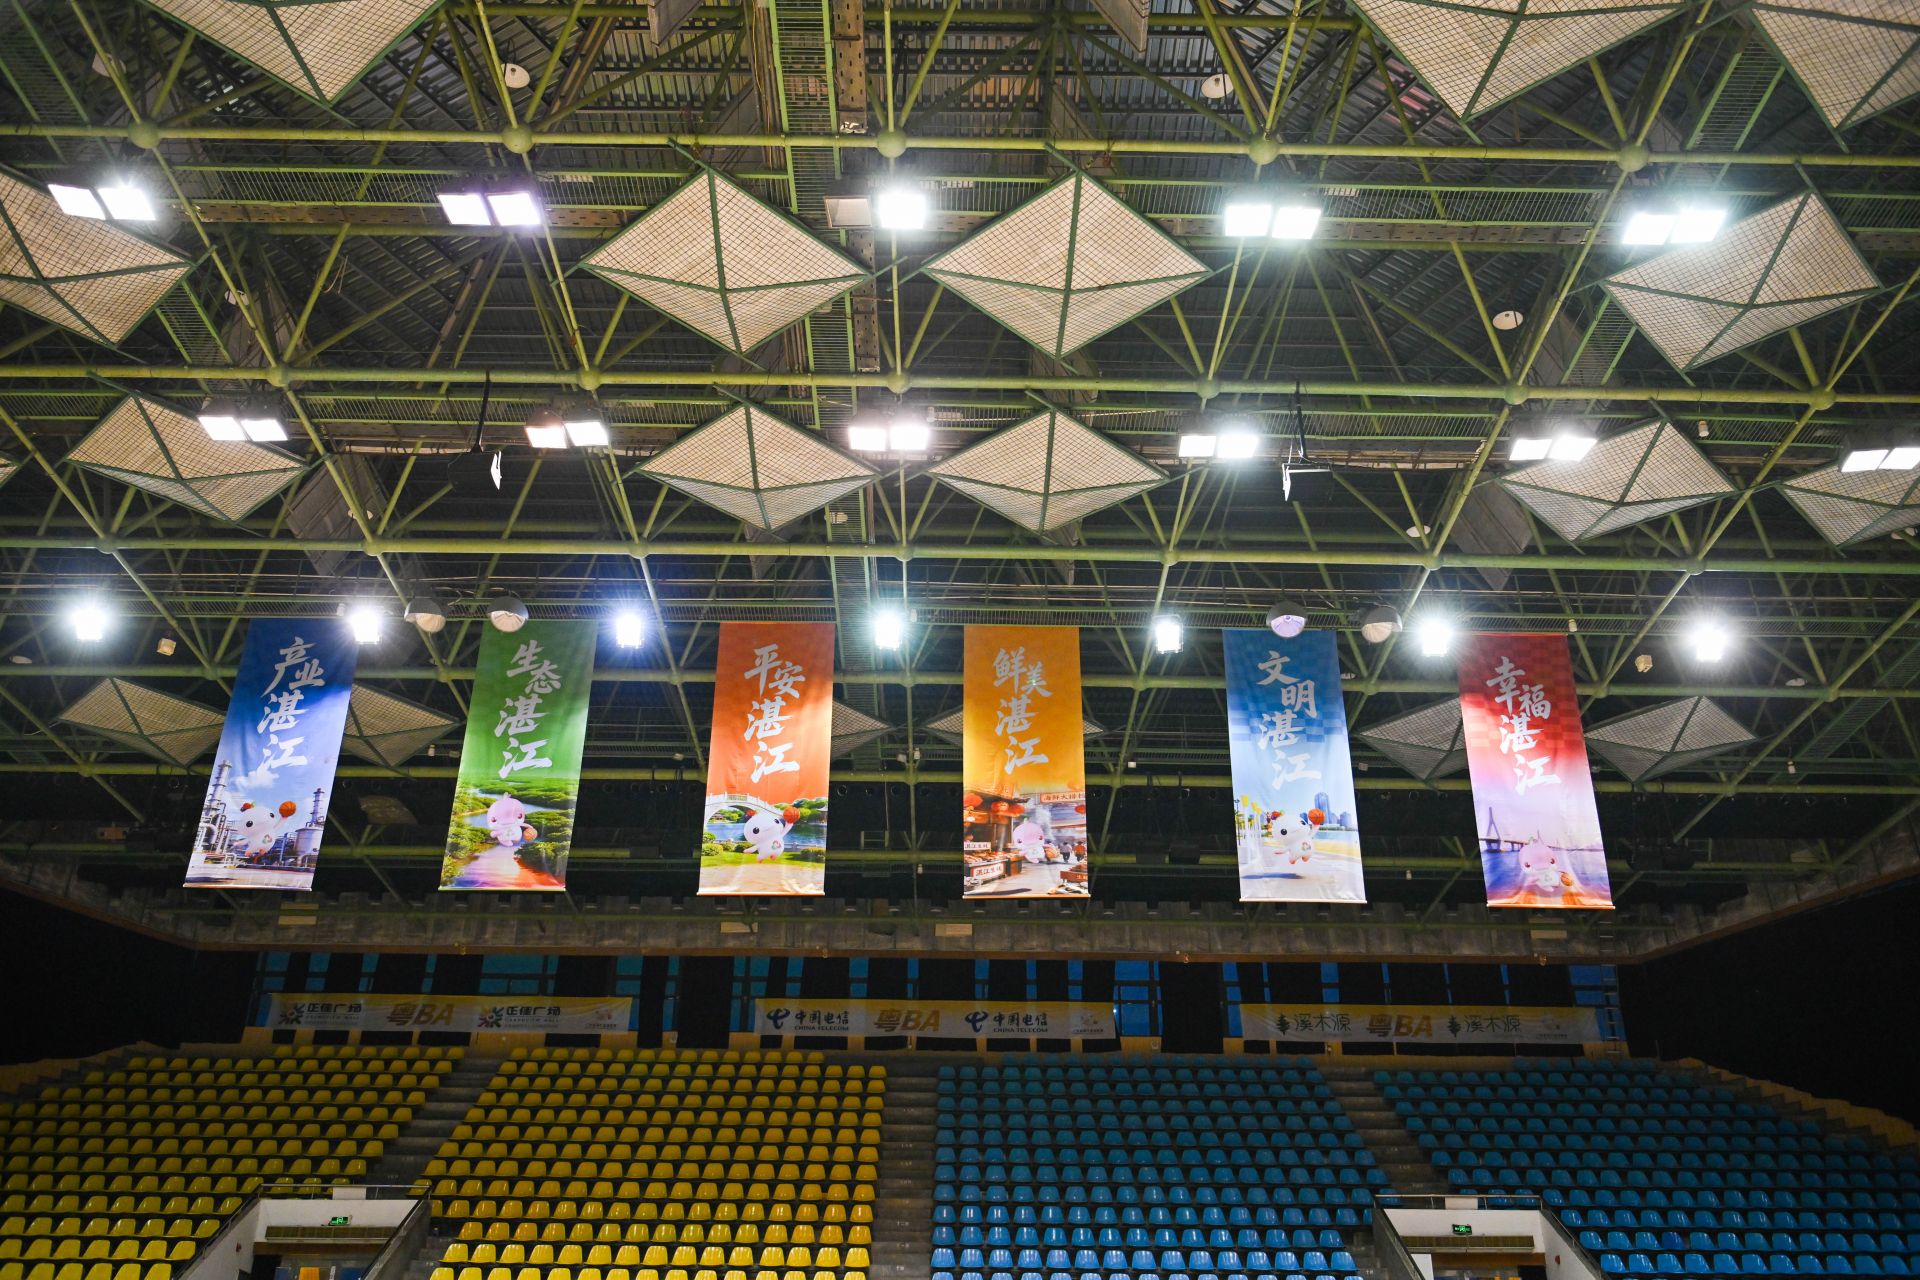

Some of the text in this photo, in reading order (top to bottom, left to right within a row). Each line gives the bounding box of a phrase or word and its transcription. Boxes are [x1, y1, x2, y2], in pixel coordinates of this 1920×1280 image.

[307, 1002, 362, 1013] 正佳广场
[386, 1003, 455, 1026] 粤BA
[506, 1006, 561, 1016] 正佳广场
[795, 1010, 849, 1024] 中国电信
[874, 1009, 940, 1032] 粤BA
[993, 1012, 1048, 1026] 中国电信
[1295, 1013, 1352, 1032] 溪木源
[1366, 1014, 1433, 1037] 粤BA
[1464, 1014, 1521, 1033] 溪木源
